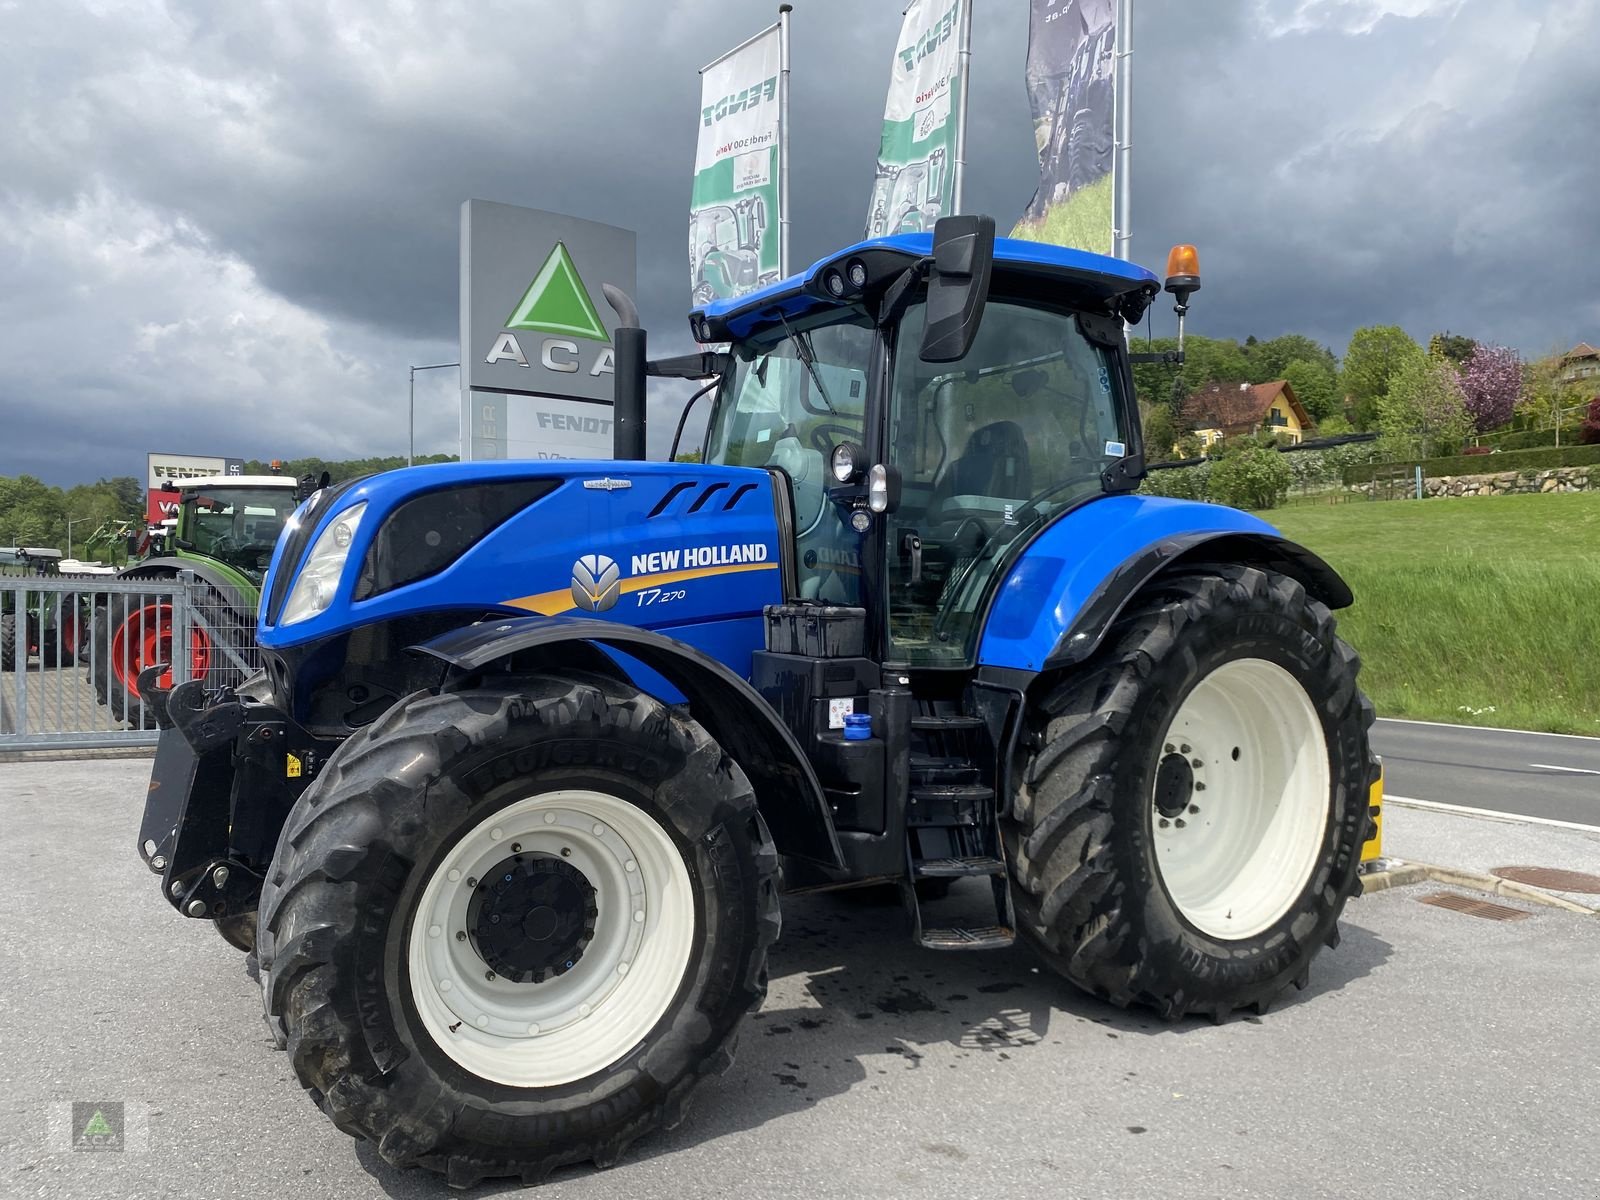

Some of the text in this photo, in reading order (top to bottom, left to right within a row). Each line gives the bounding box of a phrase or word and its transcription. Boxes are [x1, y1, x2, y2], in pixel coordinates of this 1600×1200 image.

[484, 332, 615, 376] ACA
[536, 411, 614, 435] FENDT
[153, 465, 221, 479] FENDT
[631, 543, 768, 575] NEW HOLLAND
[637, 588, 686, 607] T7.270
